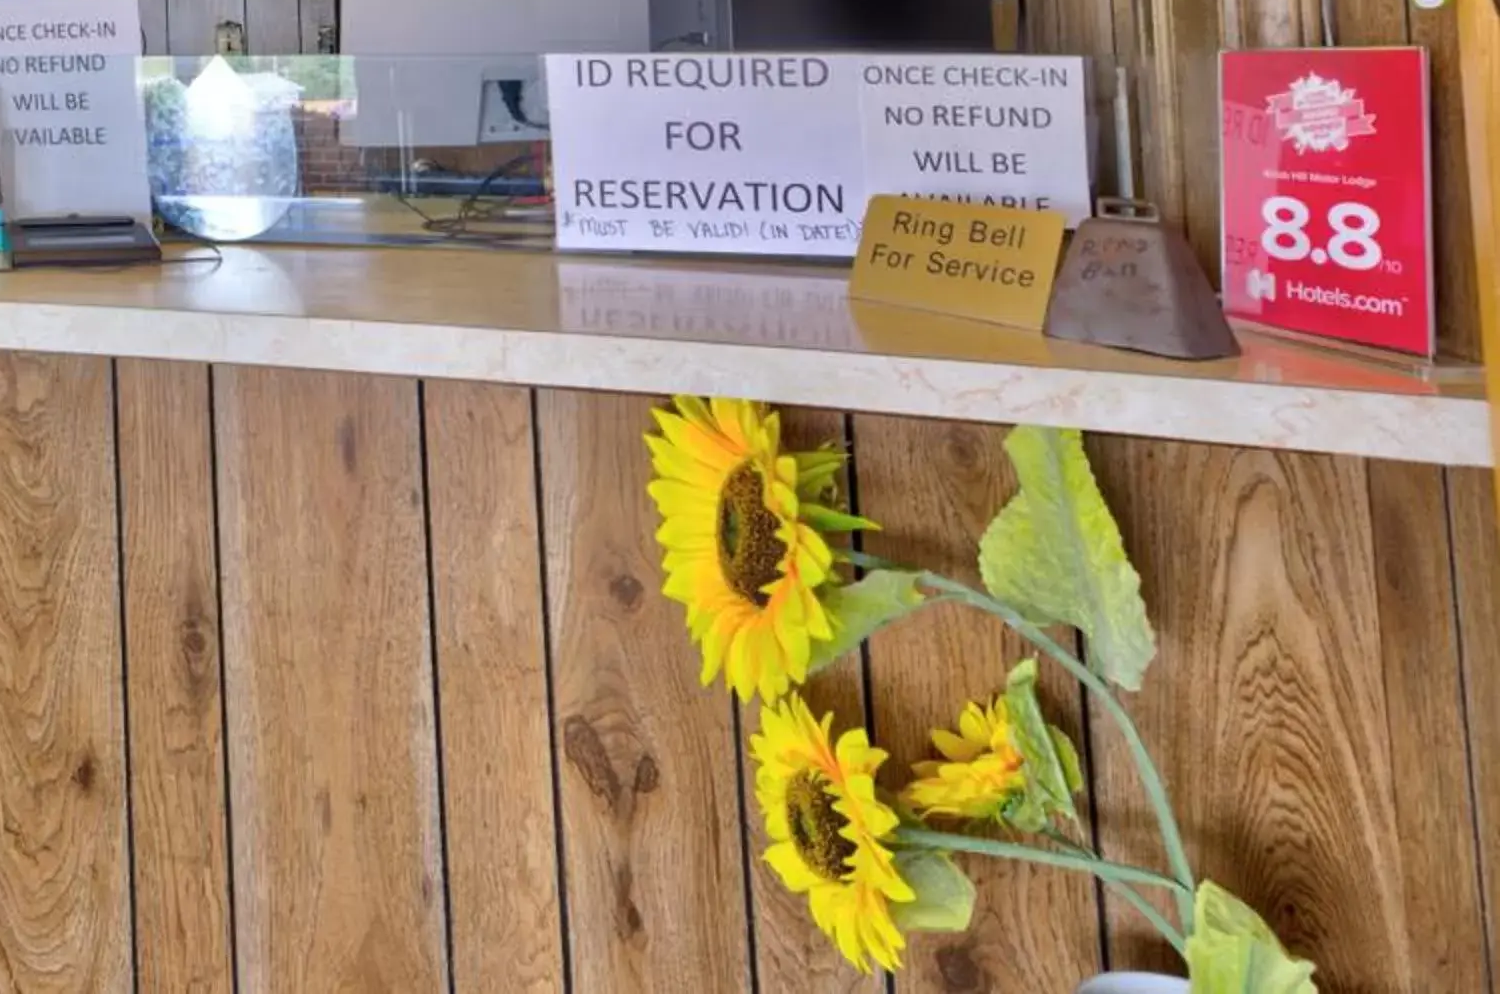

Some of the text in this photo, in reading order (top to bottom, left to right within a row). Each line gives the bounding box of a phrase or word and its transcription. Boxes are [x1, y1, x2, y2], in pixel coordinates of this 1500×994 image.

[30, 21, 117, 41] CHECK-IN
[24, 53, 106, 74] REFUND
[576, 57, 829, 90] ID REQUIRED
[863, 65, 1068, 87] ONCE CHECK-IN
[12, 91, 91, 111] WILL BE
[884, 105, 1053, 129] NO REFUND
[14, 126, 108, 146] VAILABLE
[665, 121, 742, 152] FOR
[913, 150, 1027, 175] WILL BE
[1342, 174, 1377, 189] Lodge
[574, 179, 844, 214] RESERVATION
[648, 218, 675, 238] BE
[892, 210, 1027, 249] Ring Bell
[1261, 195, 1382, 271] 8.8
[870, 243, 1035, 288] For Service
[1286, 279, 1403, 317] Hotels.com
